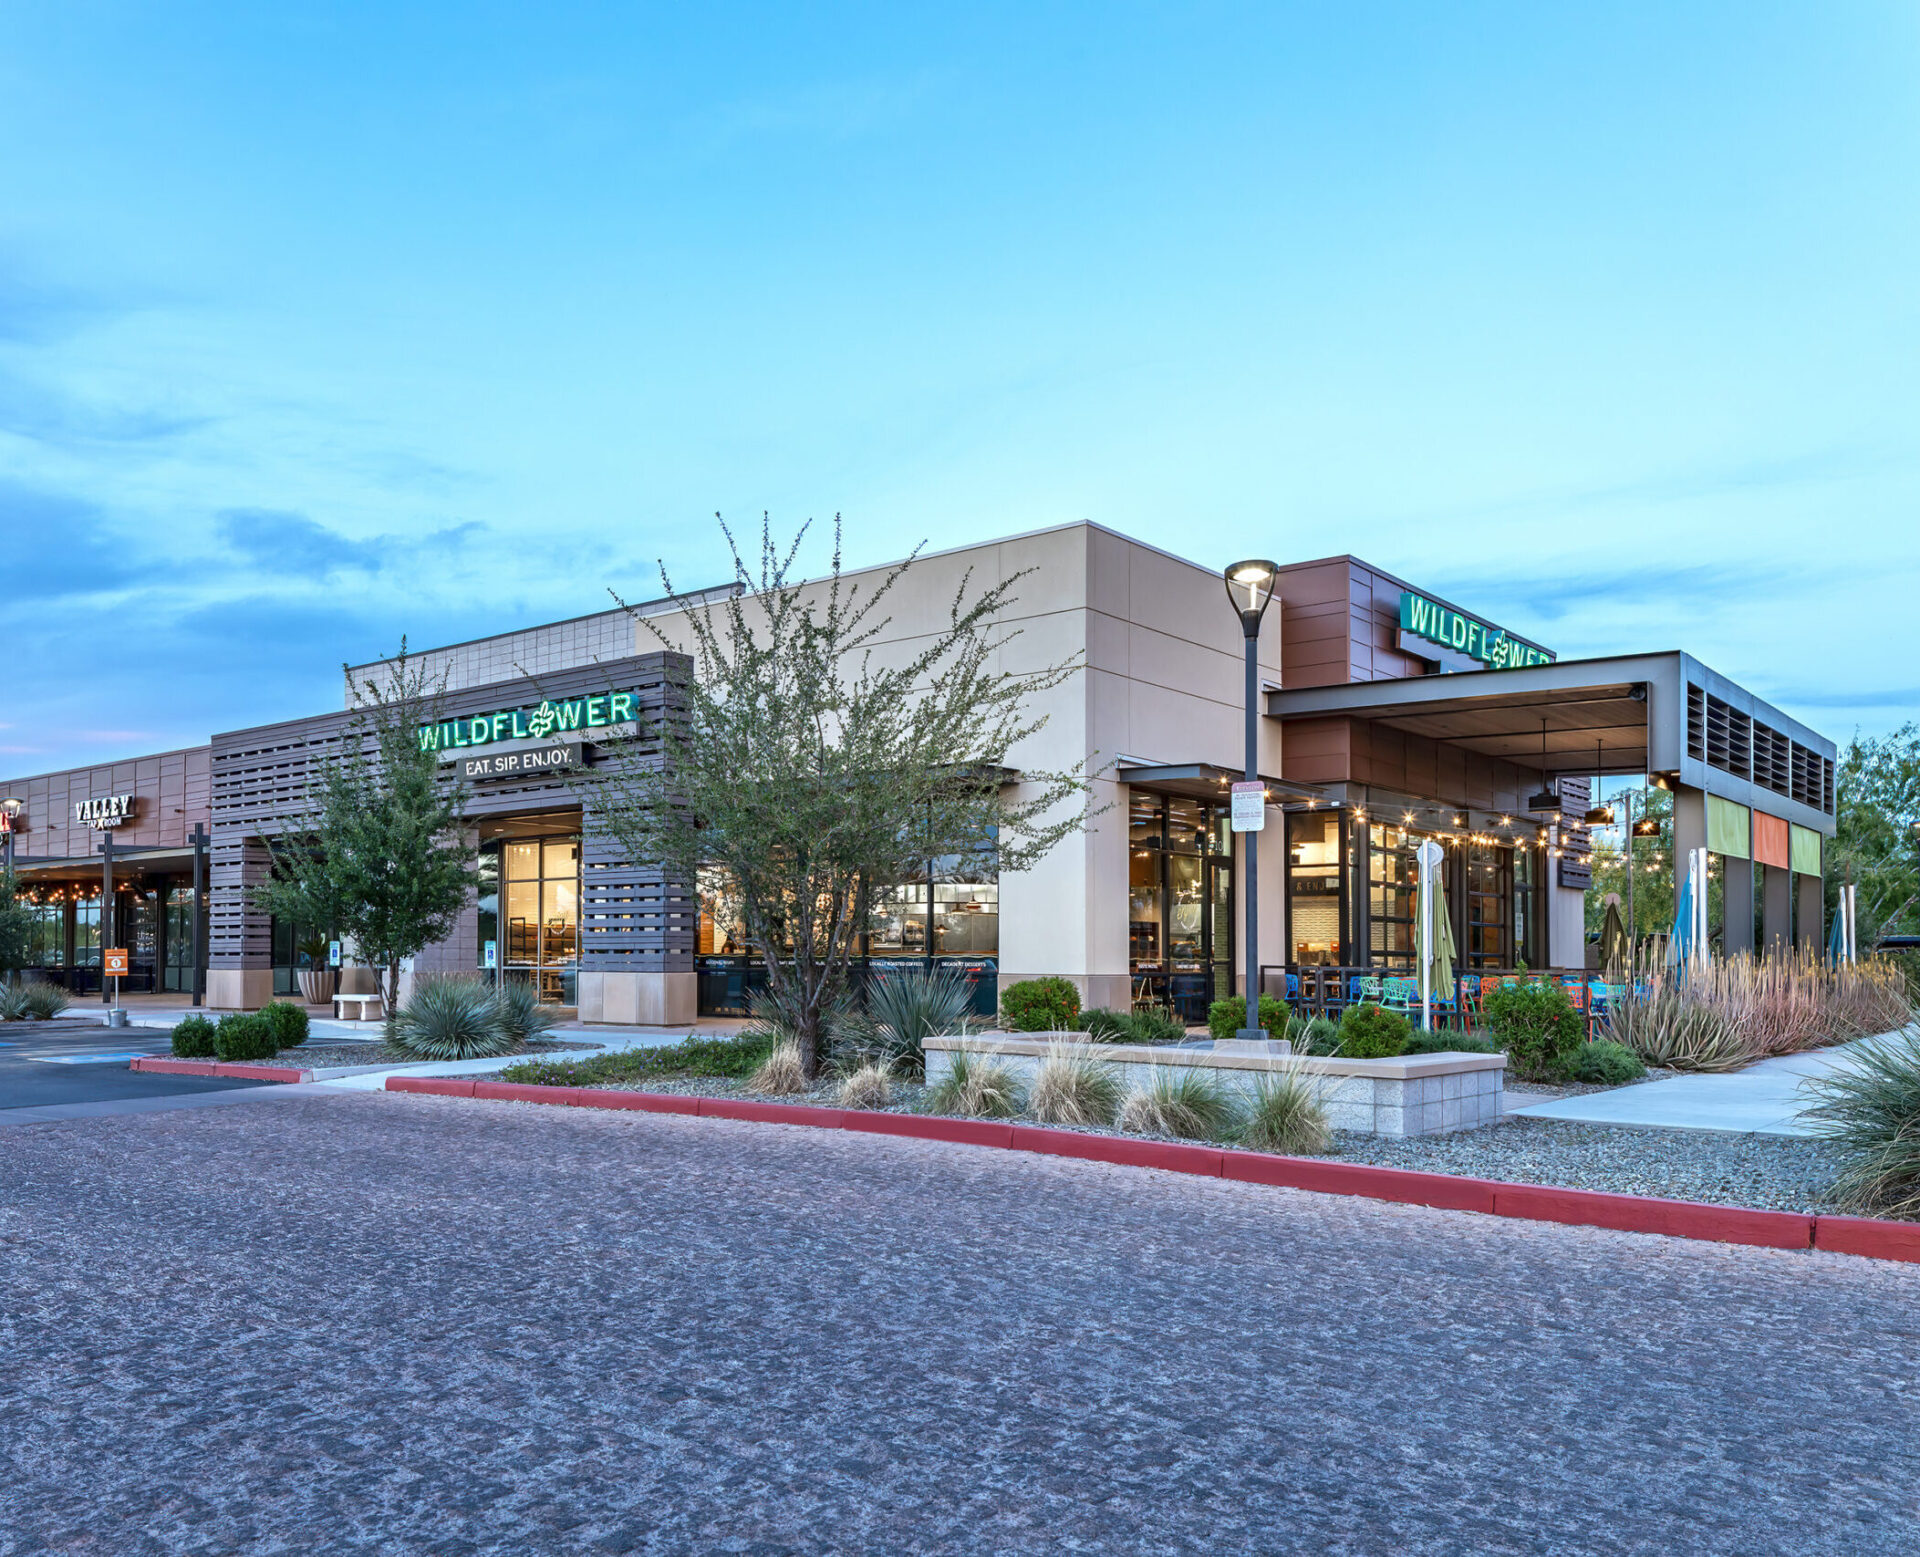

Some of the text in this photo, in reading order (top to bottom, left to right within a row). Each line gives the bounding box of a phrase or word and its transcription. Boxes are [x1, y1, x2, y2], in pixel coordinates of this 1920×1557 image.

[418, 692, 634, 751] WILDFLOWER
[466, 748, 573, 776] EAT. SIP. ENJOY.
[76, 794, 133, 820] VALLEY
[87, 817, 122, 829] TAP ROOM
